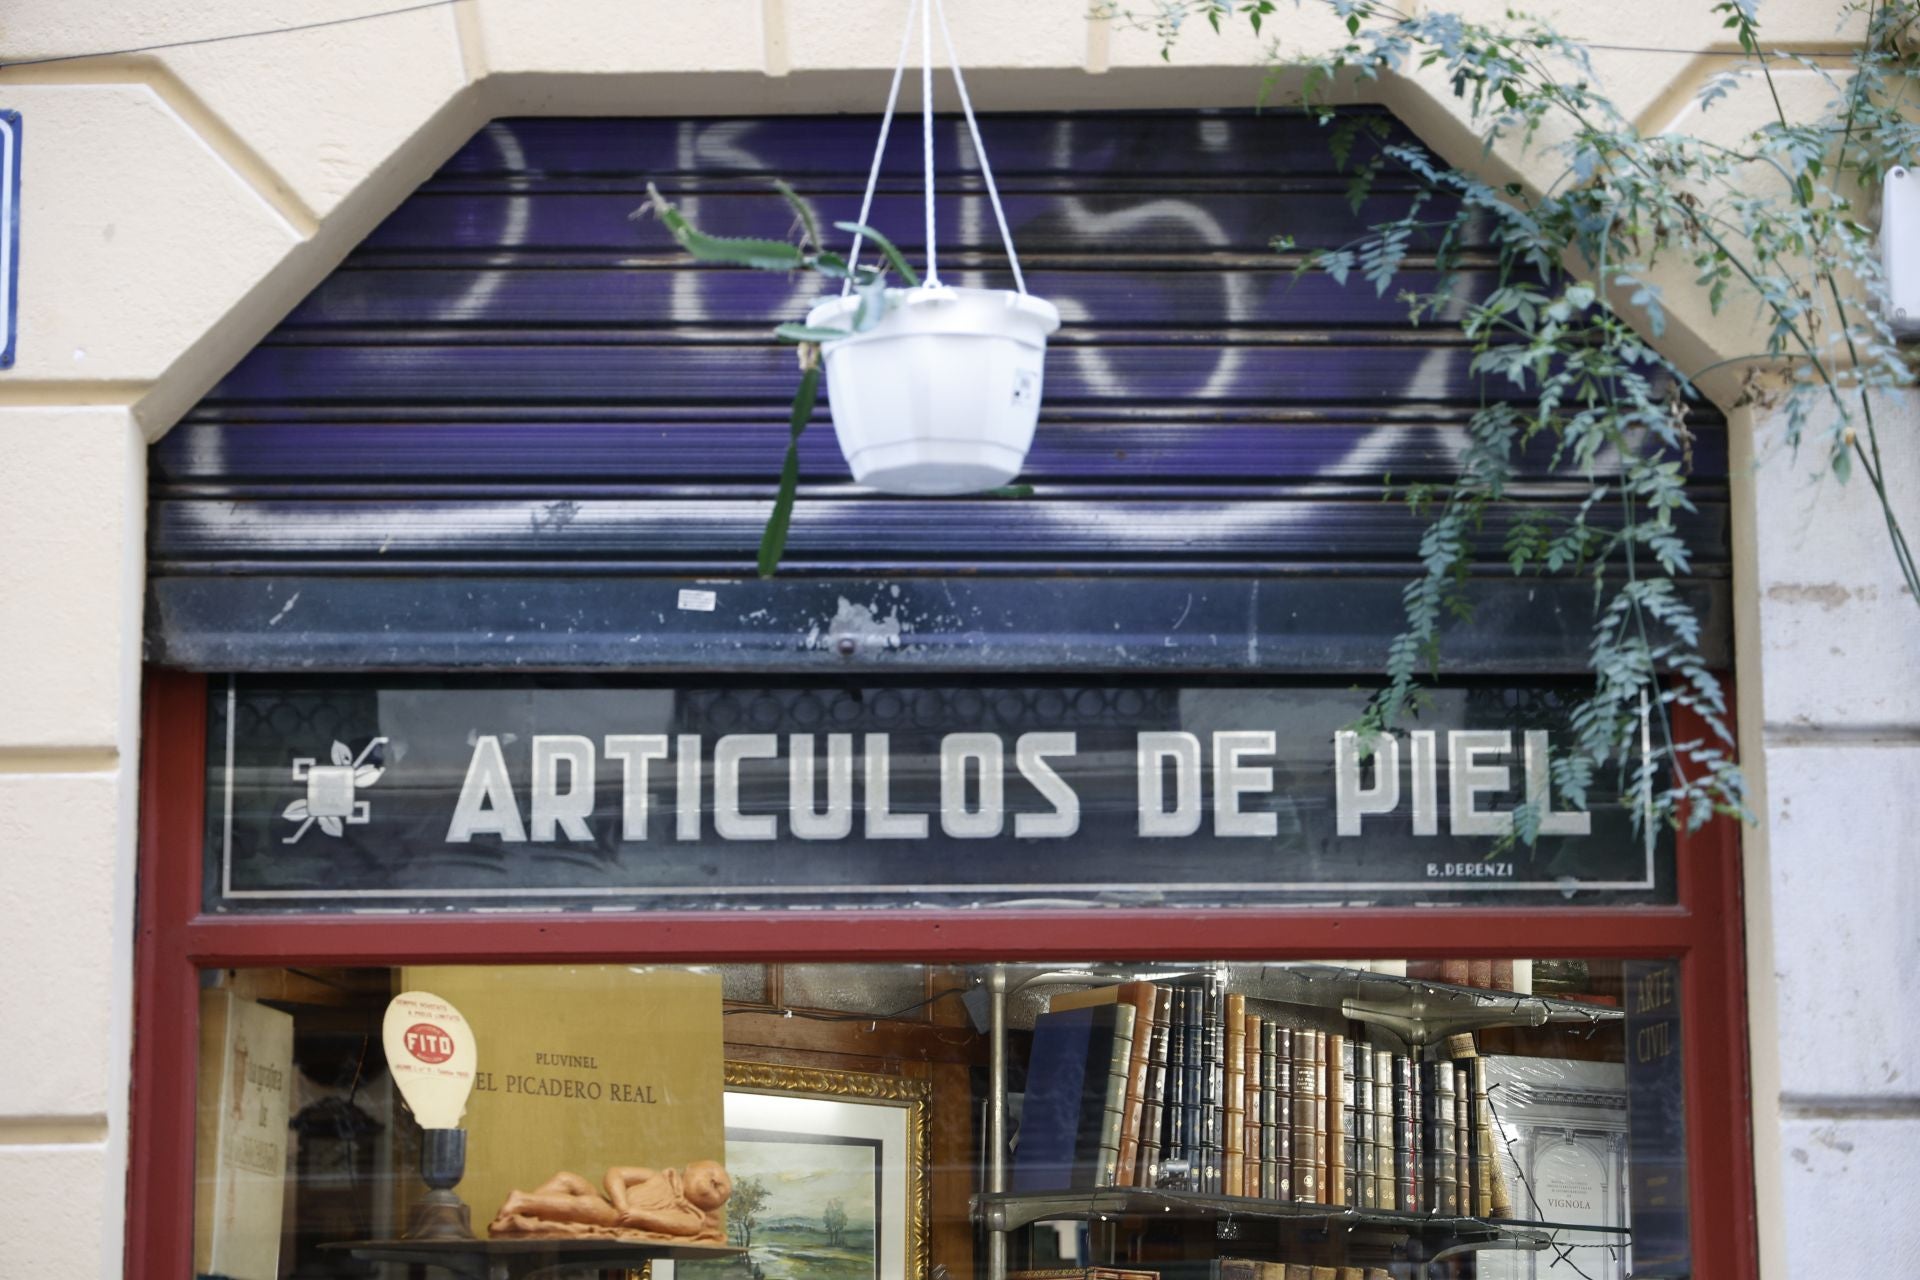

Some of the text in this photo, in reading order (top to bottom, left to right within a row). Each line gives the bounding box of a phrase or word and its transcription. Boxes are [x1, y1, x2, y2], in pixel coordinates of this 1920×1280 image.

[445, 729, 1591, 843] ARTICULOS DE PIEL
[1636, 968, 1672, 1014] ARTE
[406, 1032, 452, 1056] FITO
[1638, 1021, 1672, 1064] CIVIL
[535, 1052, 598, 1070] PLUVINEL
[475, 1072, 657, 1105] EL PICADERO REAL
[1547, 1198, 1591, 1210] VIGNOLA
